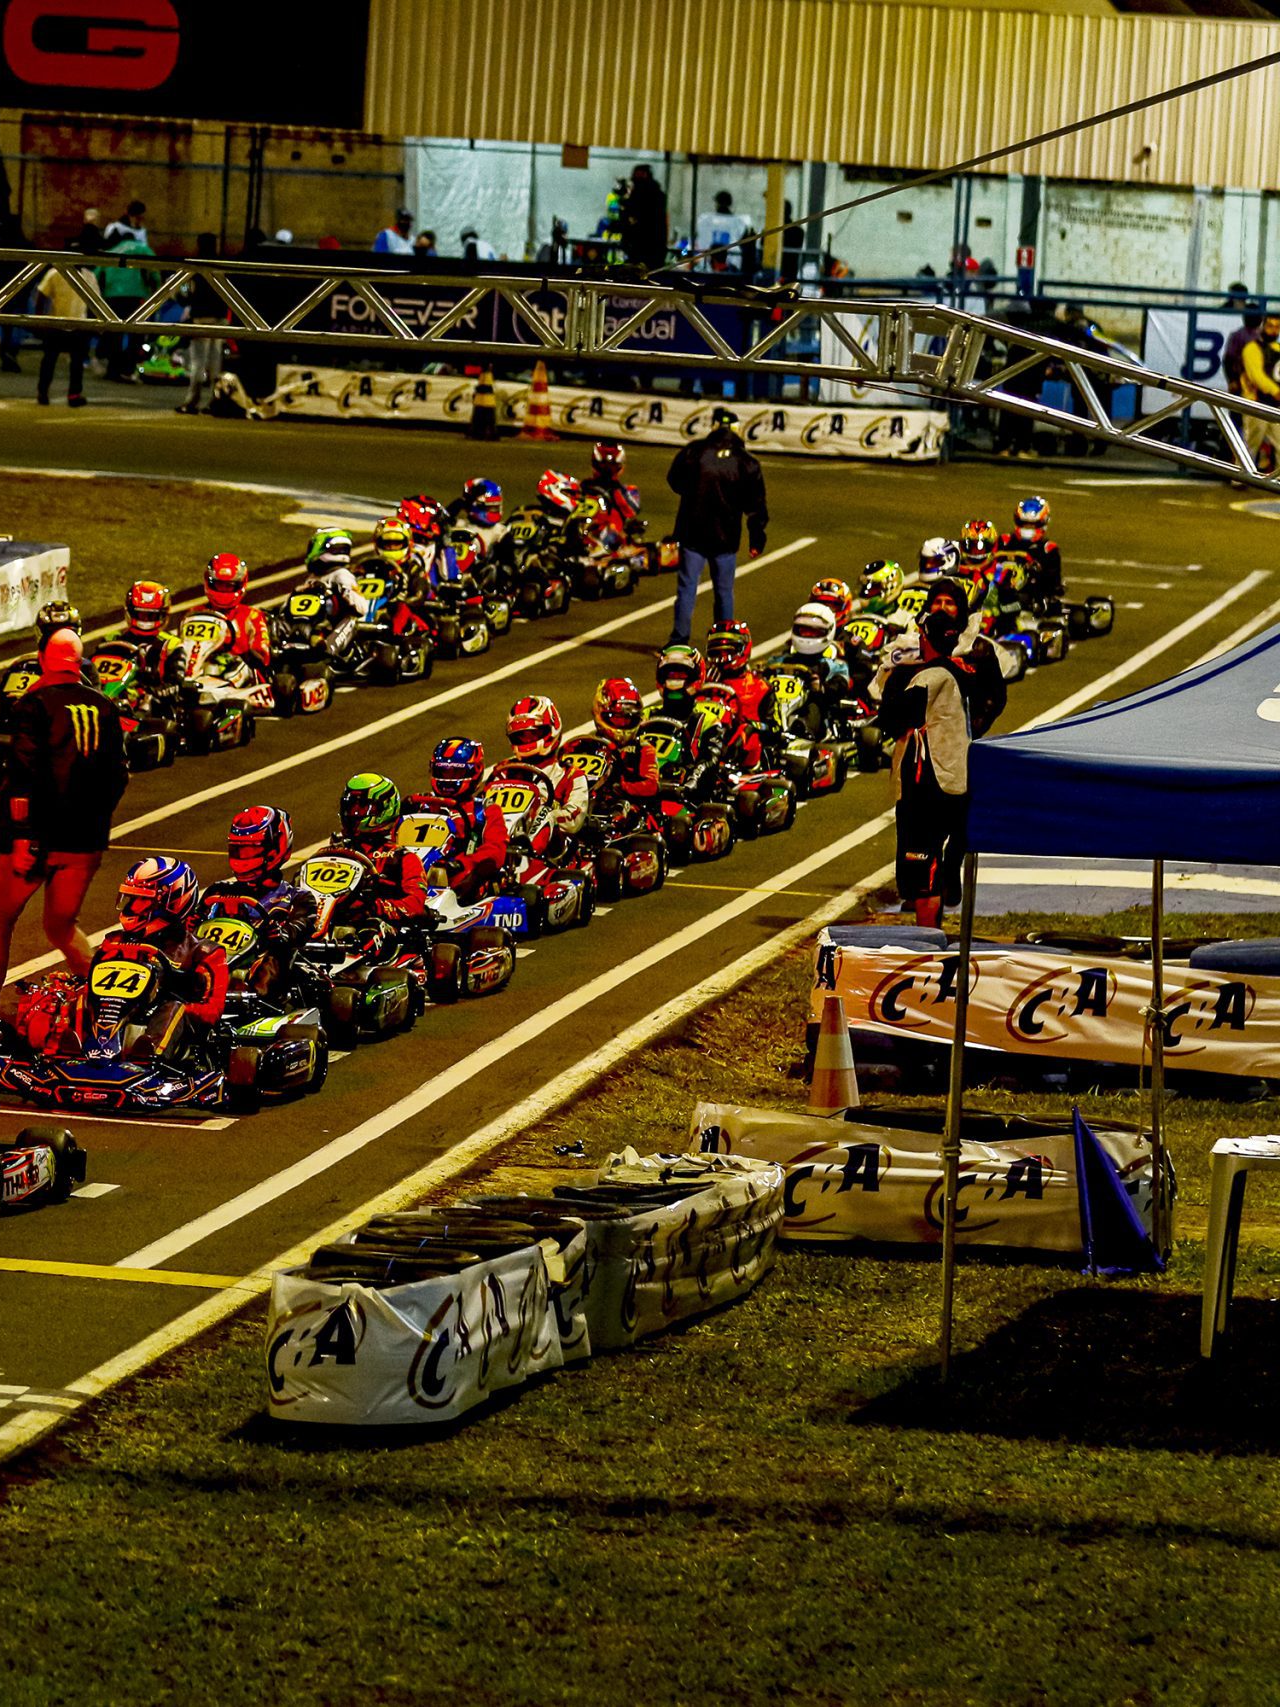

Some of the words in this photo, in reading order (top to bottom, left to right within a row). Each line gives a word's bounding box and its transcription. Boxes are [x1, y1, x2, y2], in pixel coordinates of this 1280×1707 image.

[185, 623, 217, 639] 821
[309, 868, 350, 884] 102
[493, 912, 524, 928] TND
[95, 970, 139, 993] 44
